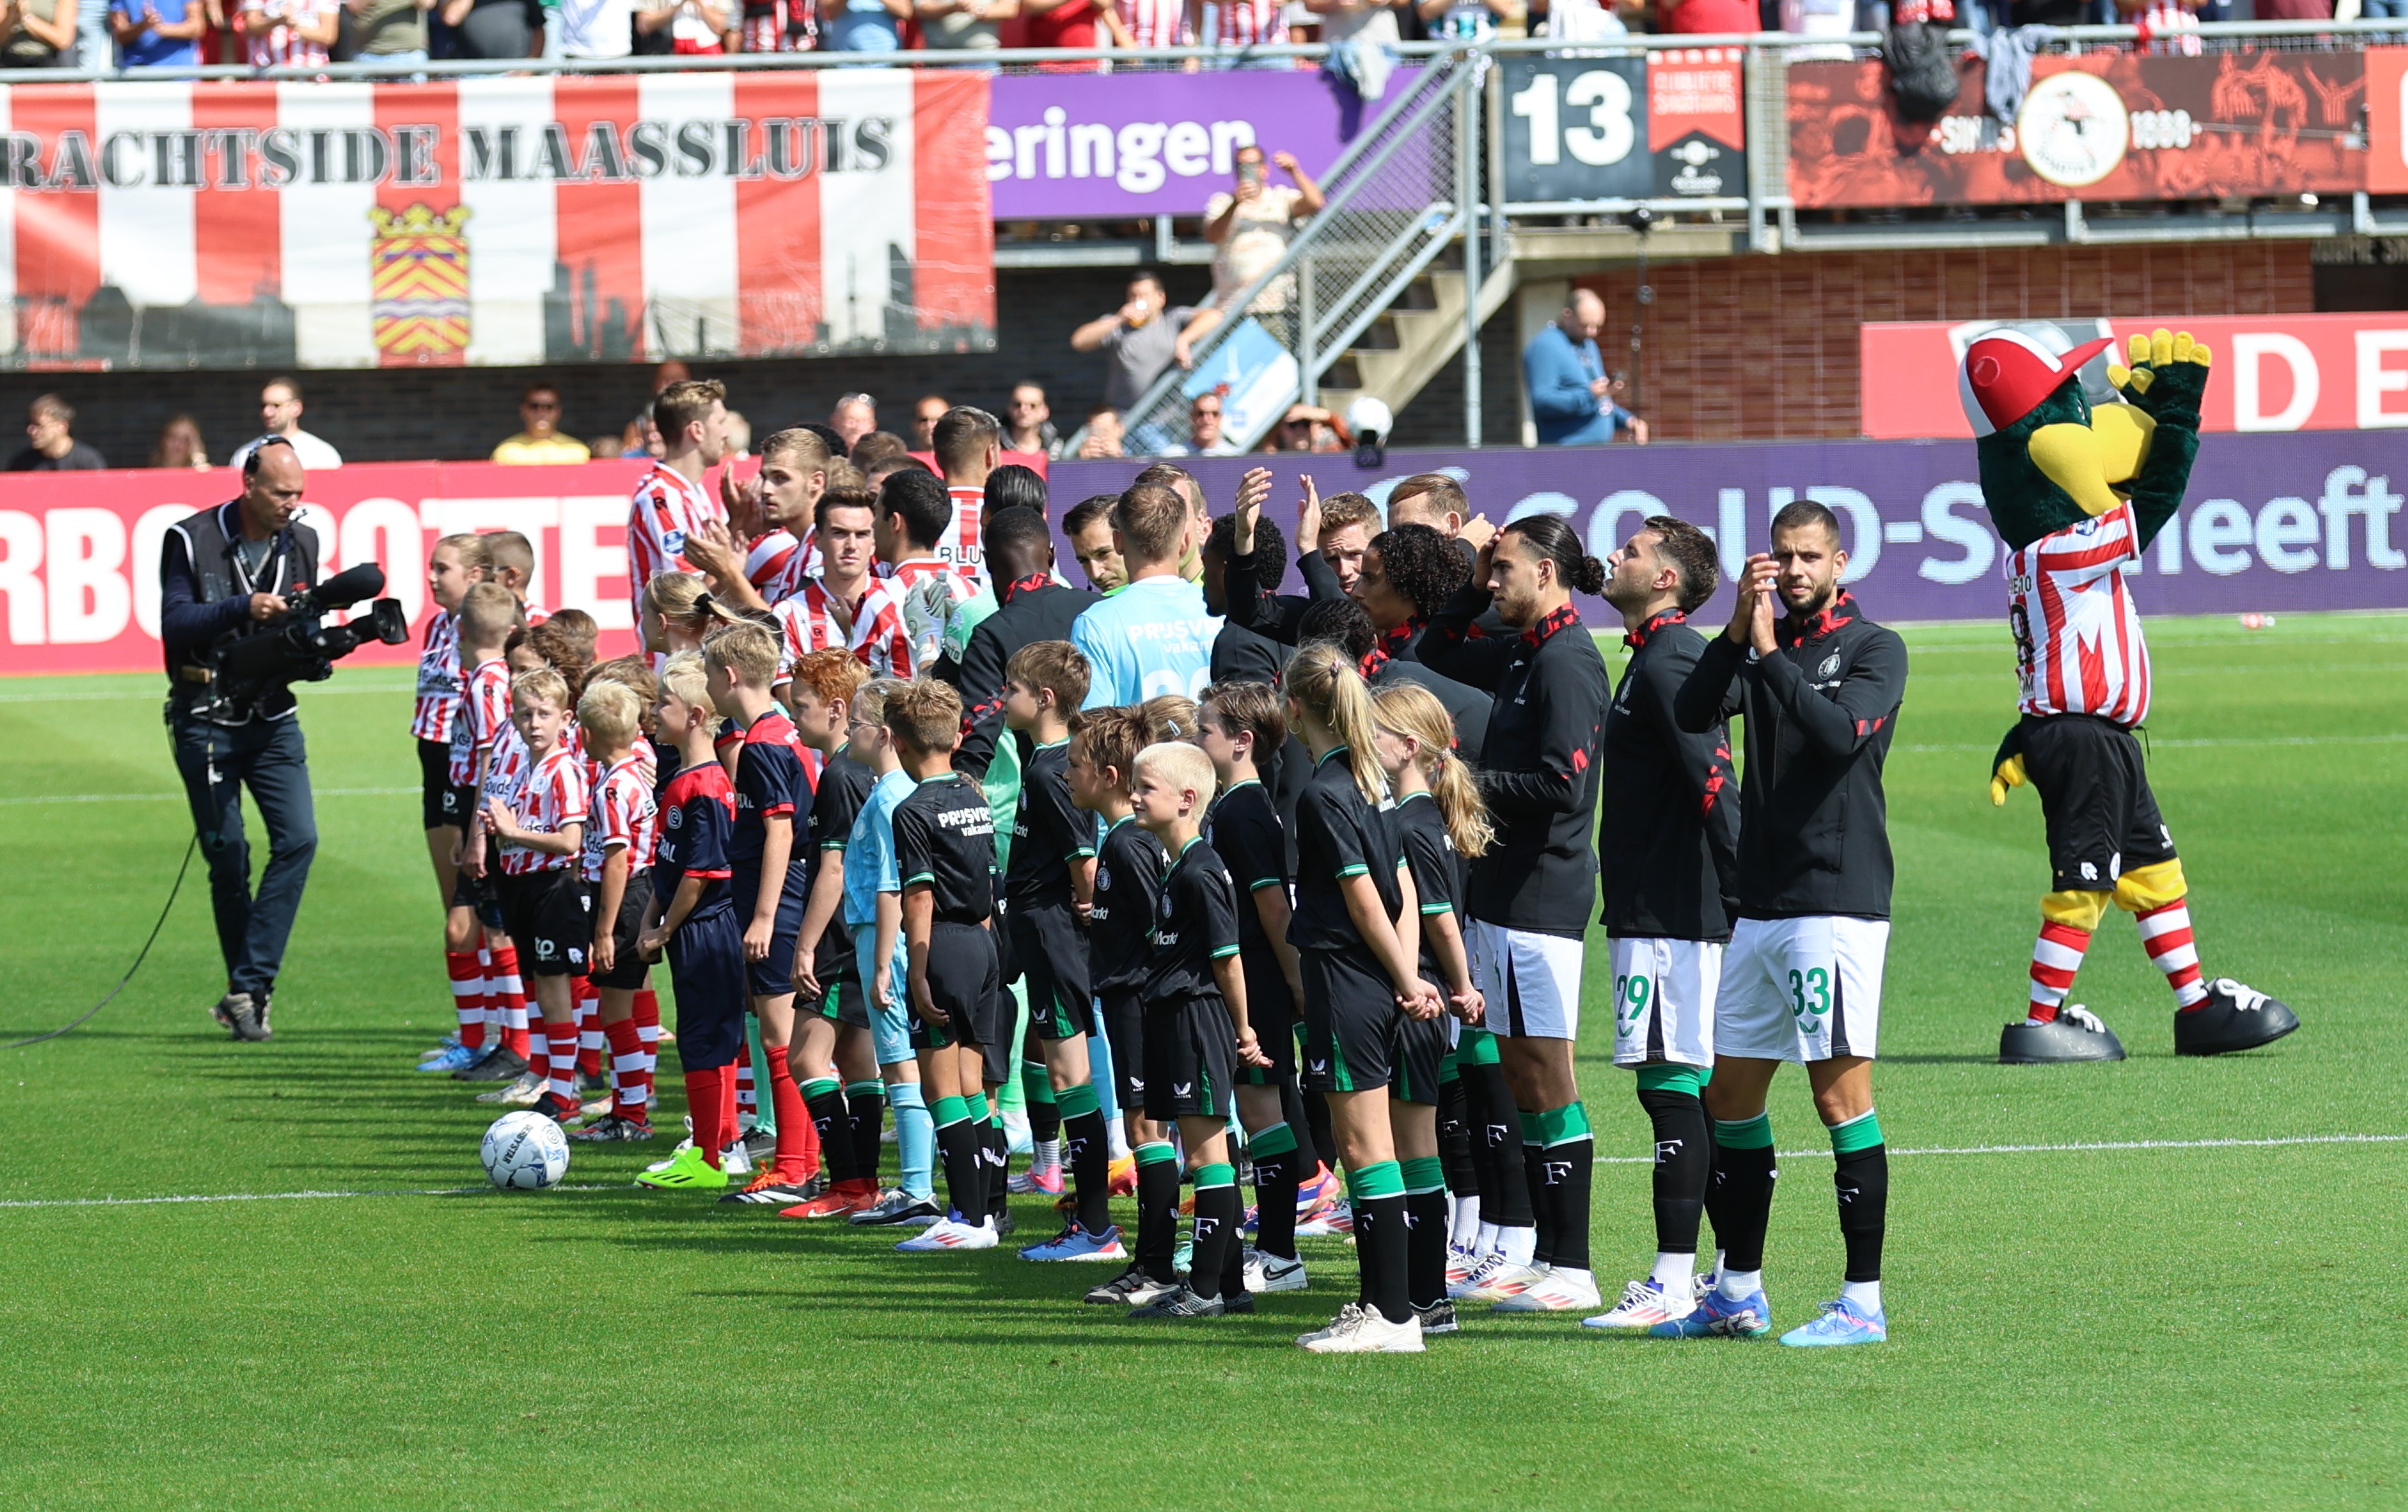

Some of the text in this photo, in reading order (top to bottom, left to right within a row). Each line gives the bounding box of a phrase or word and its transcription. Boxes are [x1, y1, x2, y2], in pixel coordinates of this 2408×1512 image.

[1511, 69, 1635, 166] 13
[460, 118, 892, 185] MAASSLUIS
[1617, 974, 1650, 1020] 29
[1788, 967, 1831, 1017] 33
